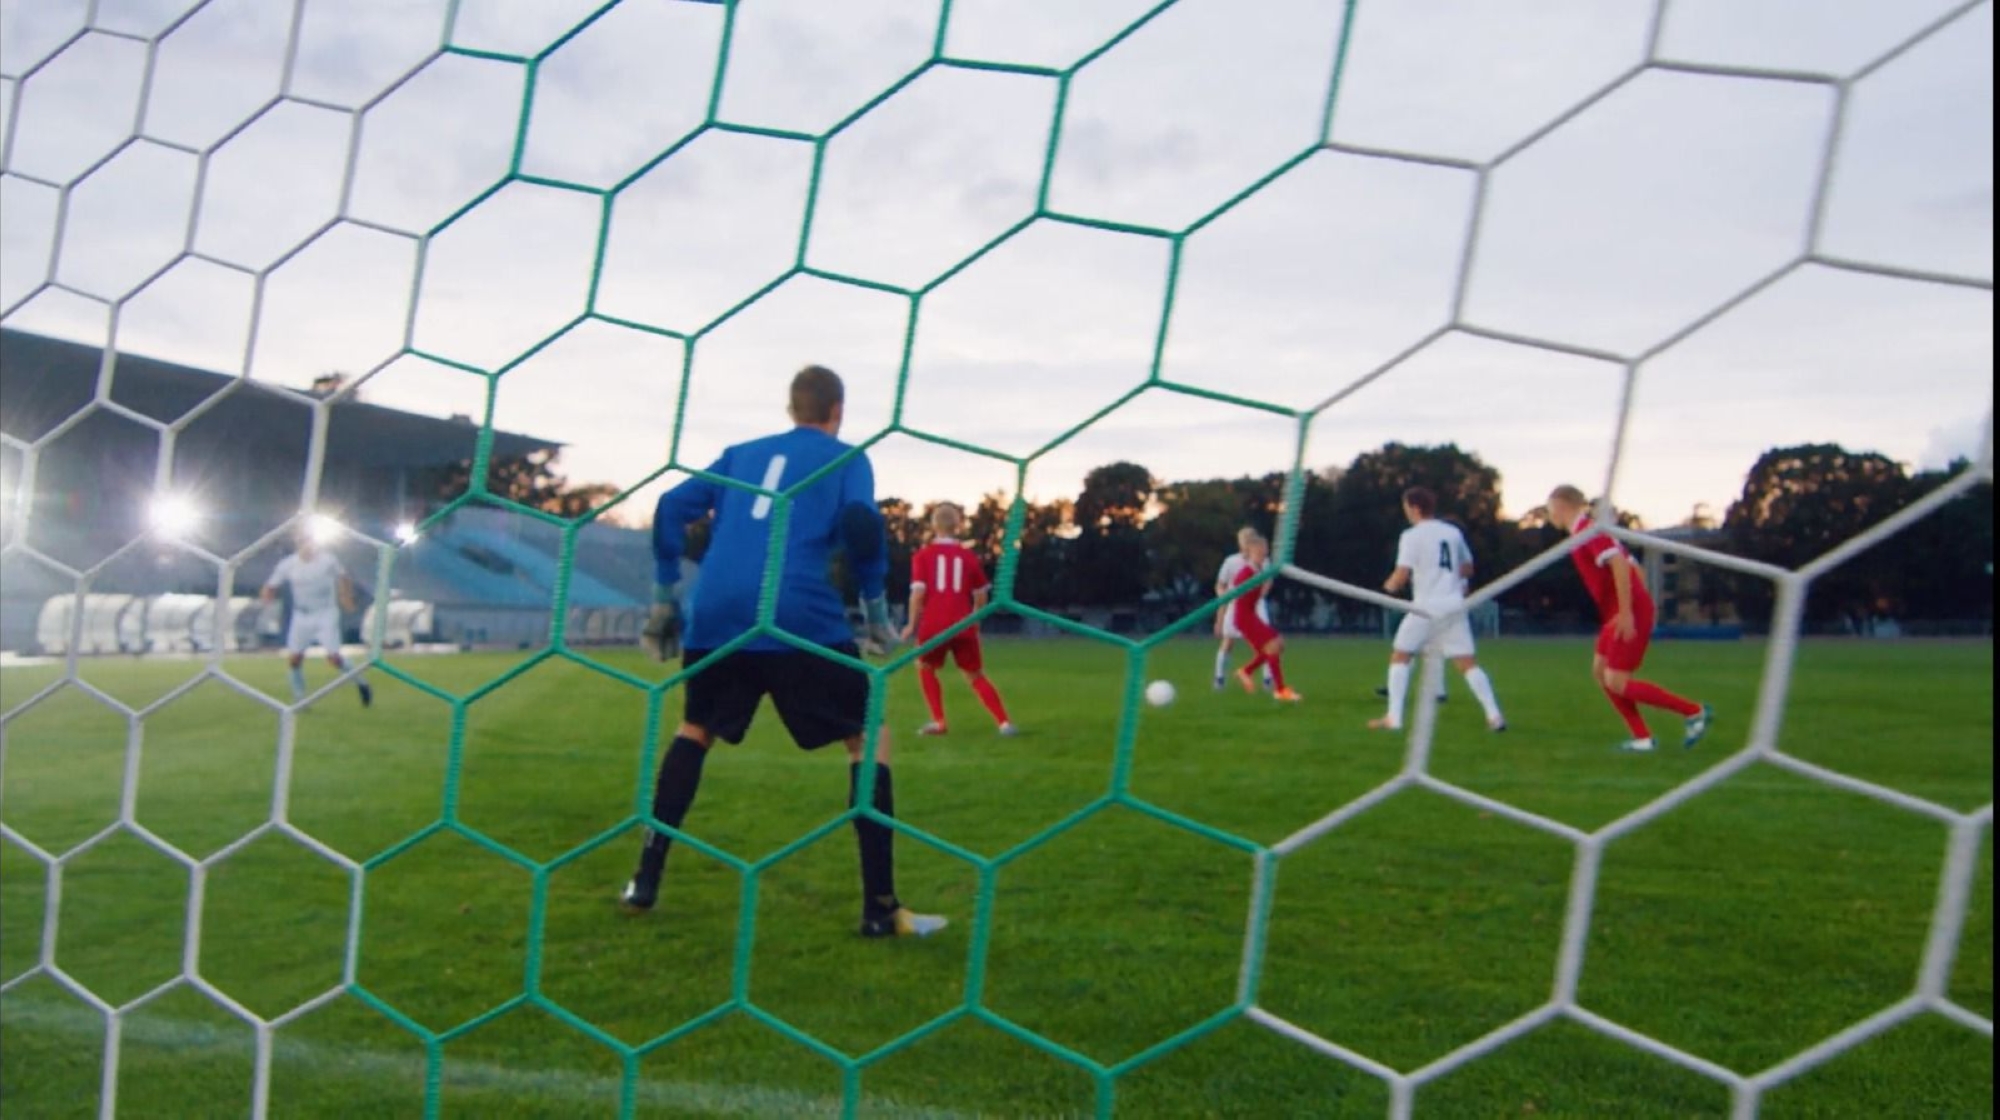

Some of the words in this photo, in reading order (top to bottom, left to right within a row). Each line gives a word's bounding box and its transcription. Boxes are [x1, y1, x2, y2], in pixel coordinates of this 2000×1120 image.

[752, 454, 786, 519] 1
[937, 554, 963, 593] 11
[1439, 540, 1452, 572] 4
